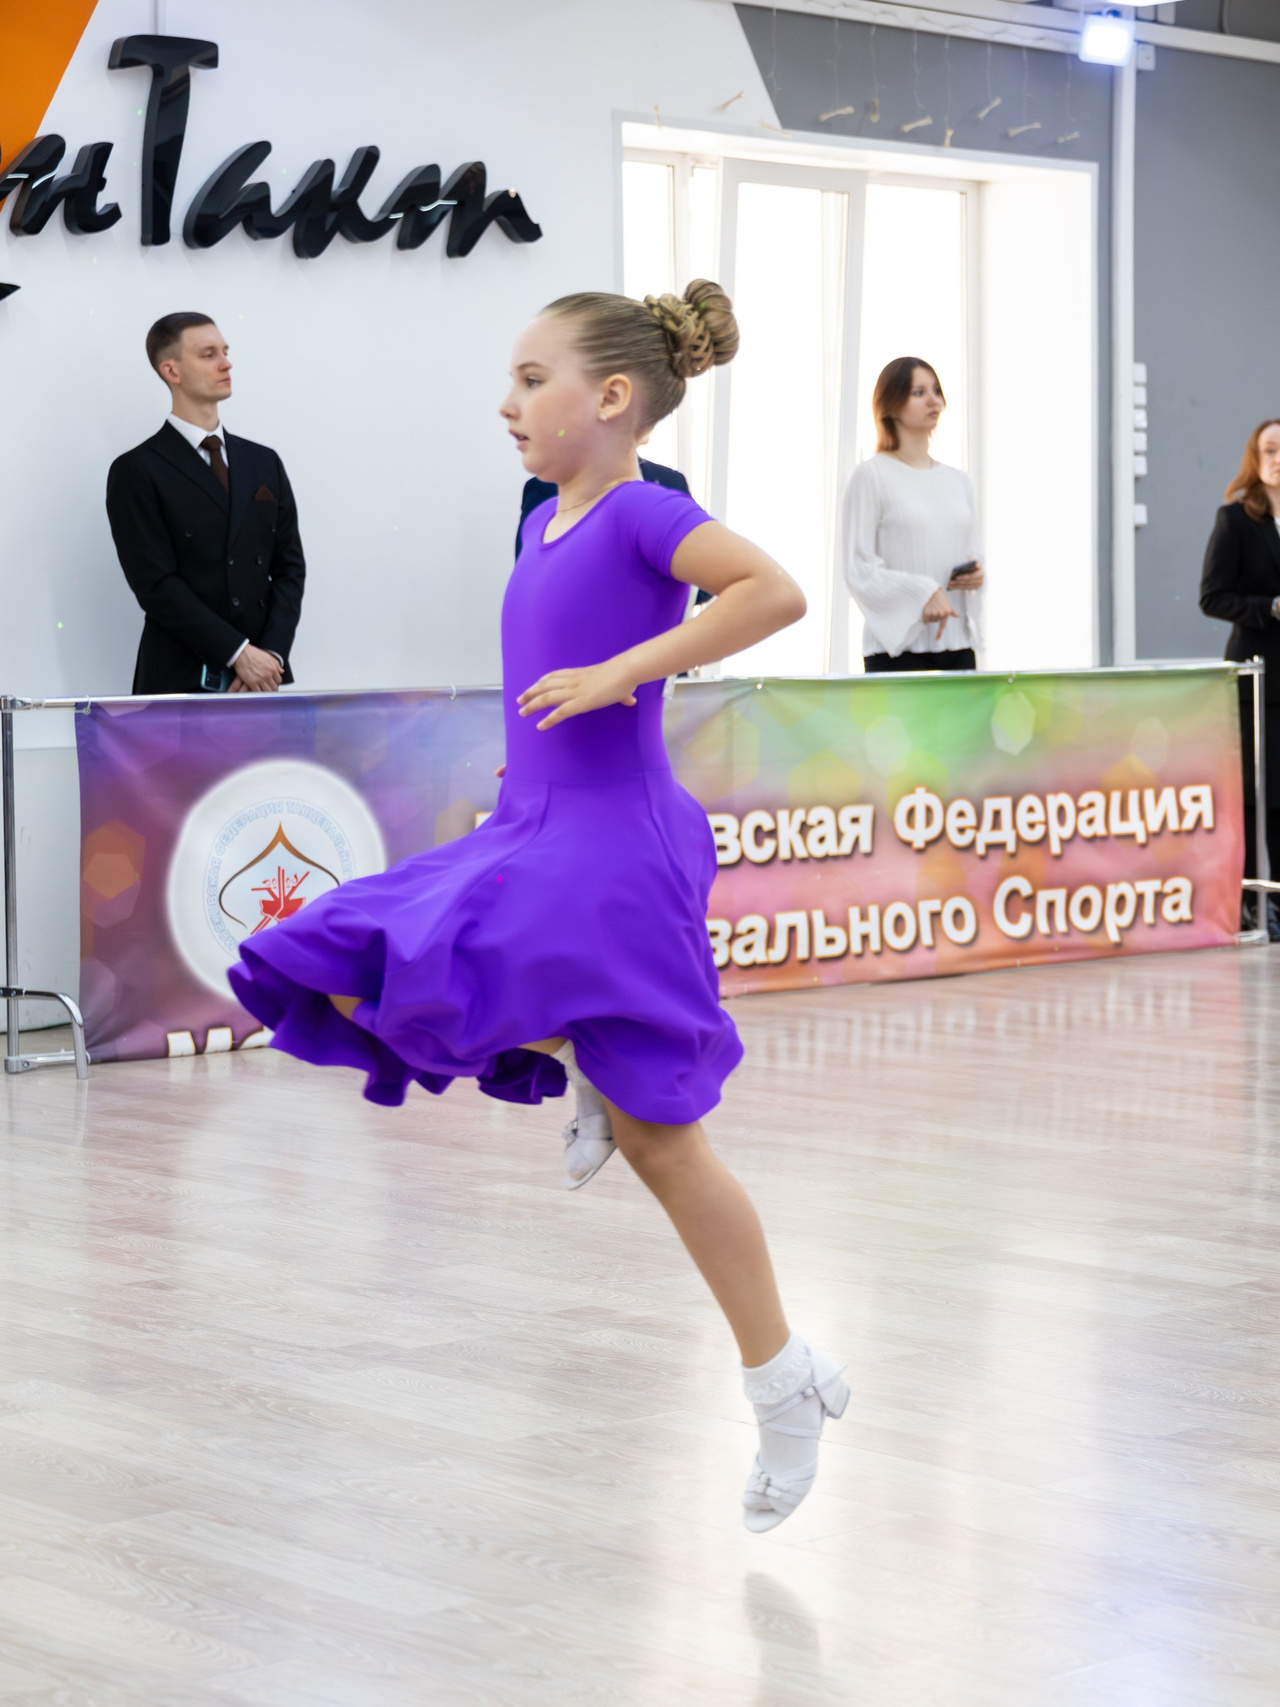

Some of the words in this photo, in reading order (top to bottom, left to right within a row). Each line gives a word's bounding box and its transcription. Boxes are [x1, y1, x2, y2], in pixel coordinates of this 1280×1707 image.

[214, 801, 284, 856] ФЕДЕРАЦИЯ
[706, 804, 875, 867] вская
[893, 784, 1215, 857] Федерация
[207, 857, 239, 951] МОСКОВСКАЯ
[992, 874, 1194, 943] Спорта
